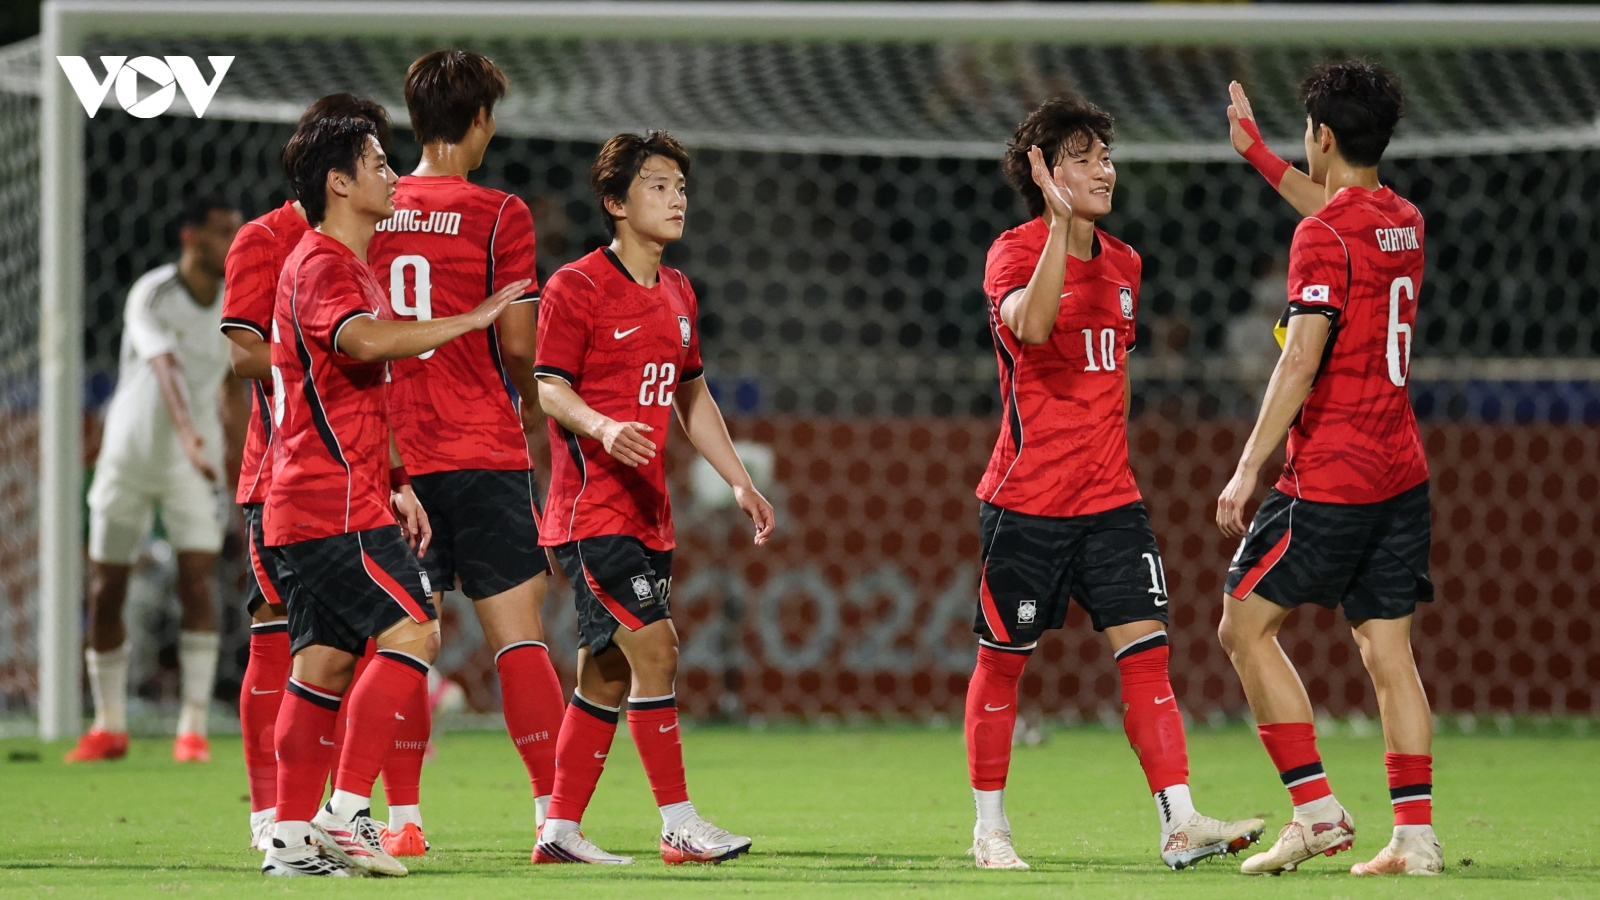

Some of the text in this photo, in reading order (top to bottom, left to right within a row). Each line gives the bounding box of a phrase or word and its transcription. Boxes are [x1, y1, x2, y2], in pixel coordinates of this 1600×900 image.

[1375, 226, 1420, 252] GIHYUK
[389, 254, 435, 360] 9
[1081, 328, 1116, 372] 10
[1386, 276, 1414, 387] 6
[638, 362, 676, 407] 22
[515, 730, 549, 746] KOREA
